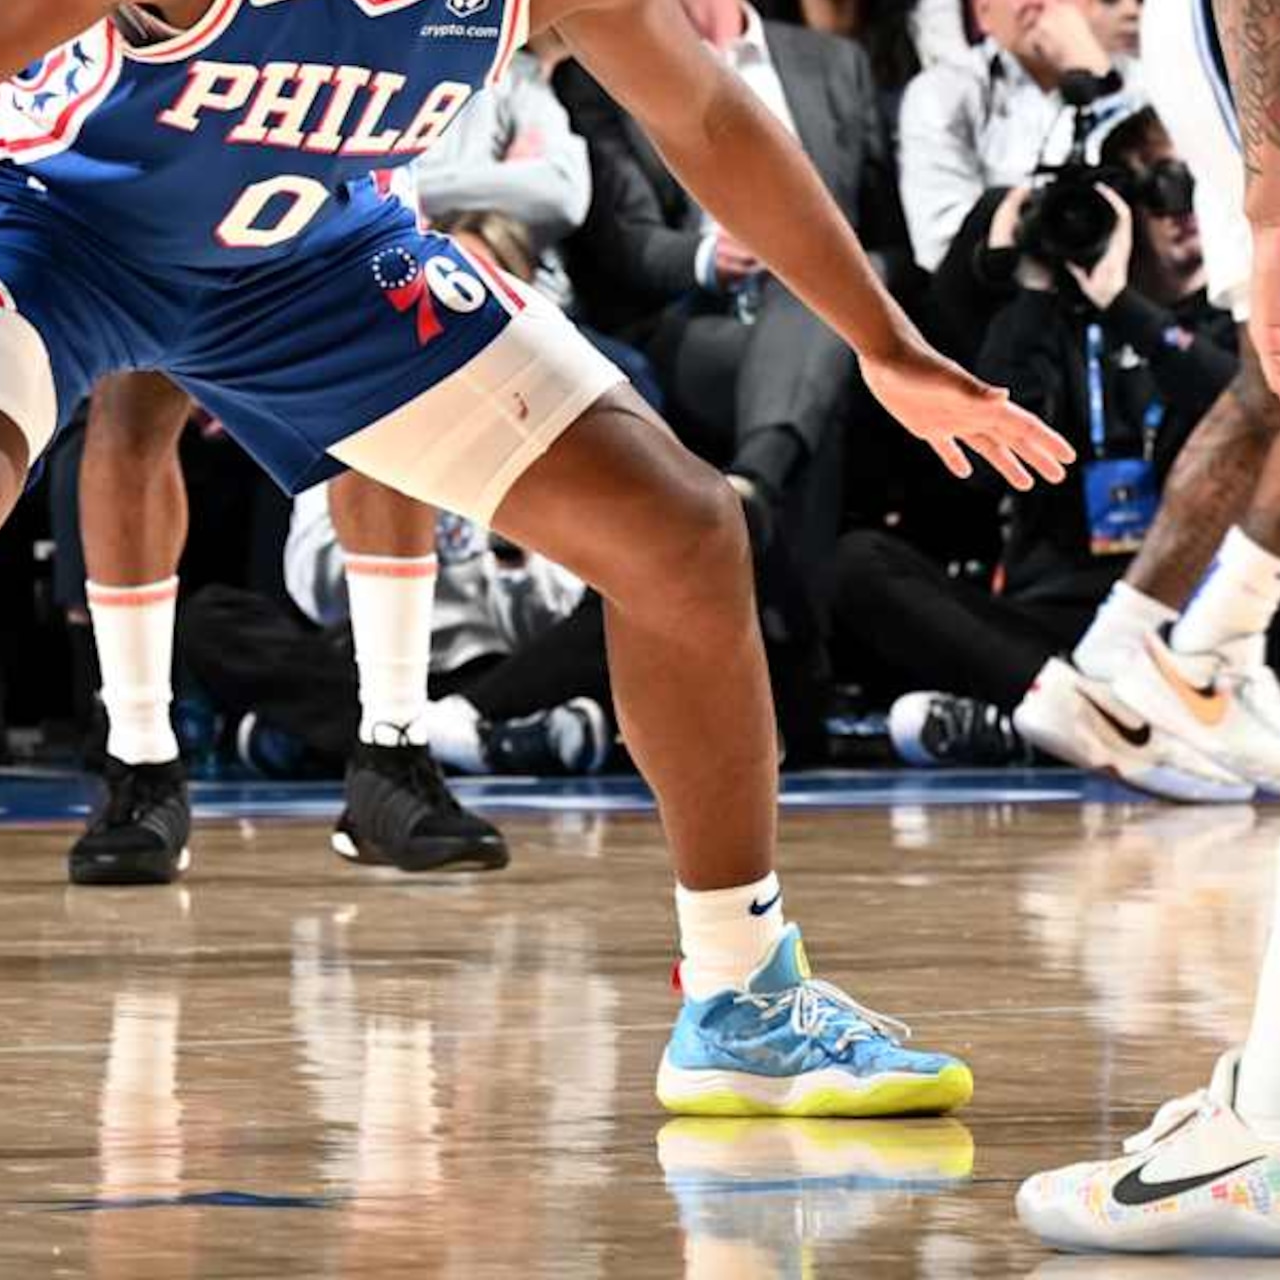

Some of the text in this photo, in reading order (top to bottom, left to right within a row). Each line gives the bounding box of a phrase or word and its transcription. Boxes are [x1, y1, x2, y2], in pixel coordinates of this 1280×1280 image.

[420, 23, 499, 39] crypto.com
[156, 59, 472, 157] PHILA
[214, 173, 330, 248] 0
